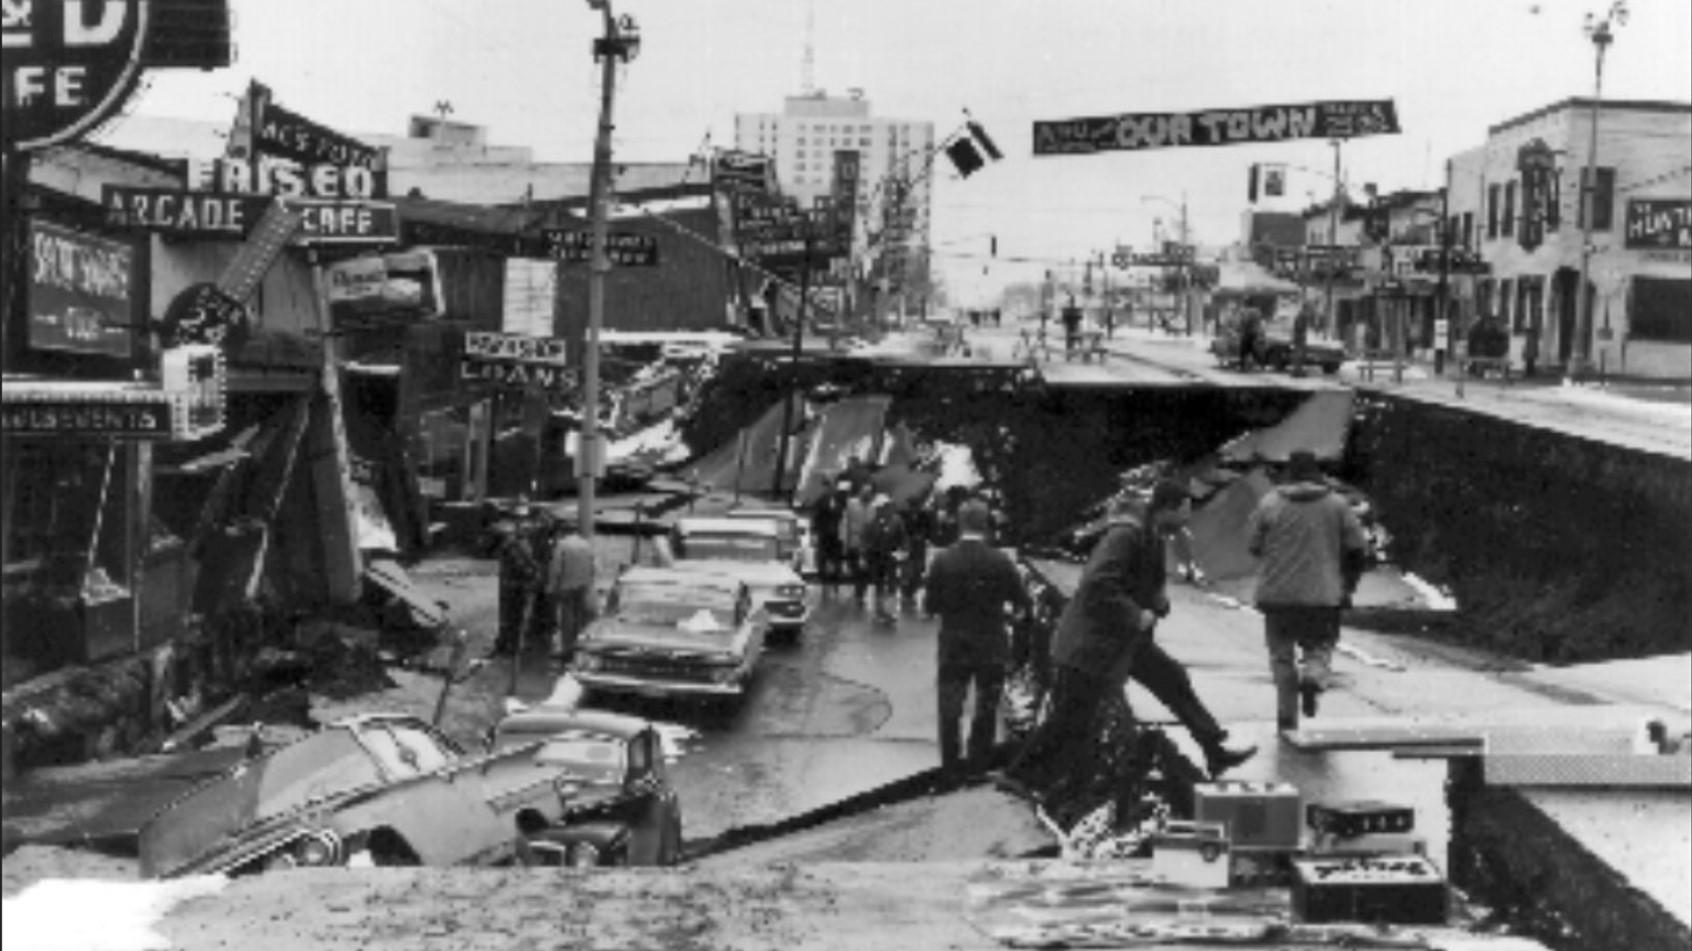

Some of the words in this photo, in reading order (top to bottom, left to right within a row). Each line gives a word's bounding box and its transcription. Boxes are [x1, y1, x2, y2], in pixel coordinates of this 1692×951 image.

[1115, 113, 1192, 147] OUR
[1201, 106, 1316, 144] TOWN
[105, 192, 244, 231] ARCADE
